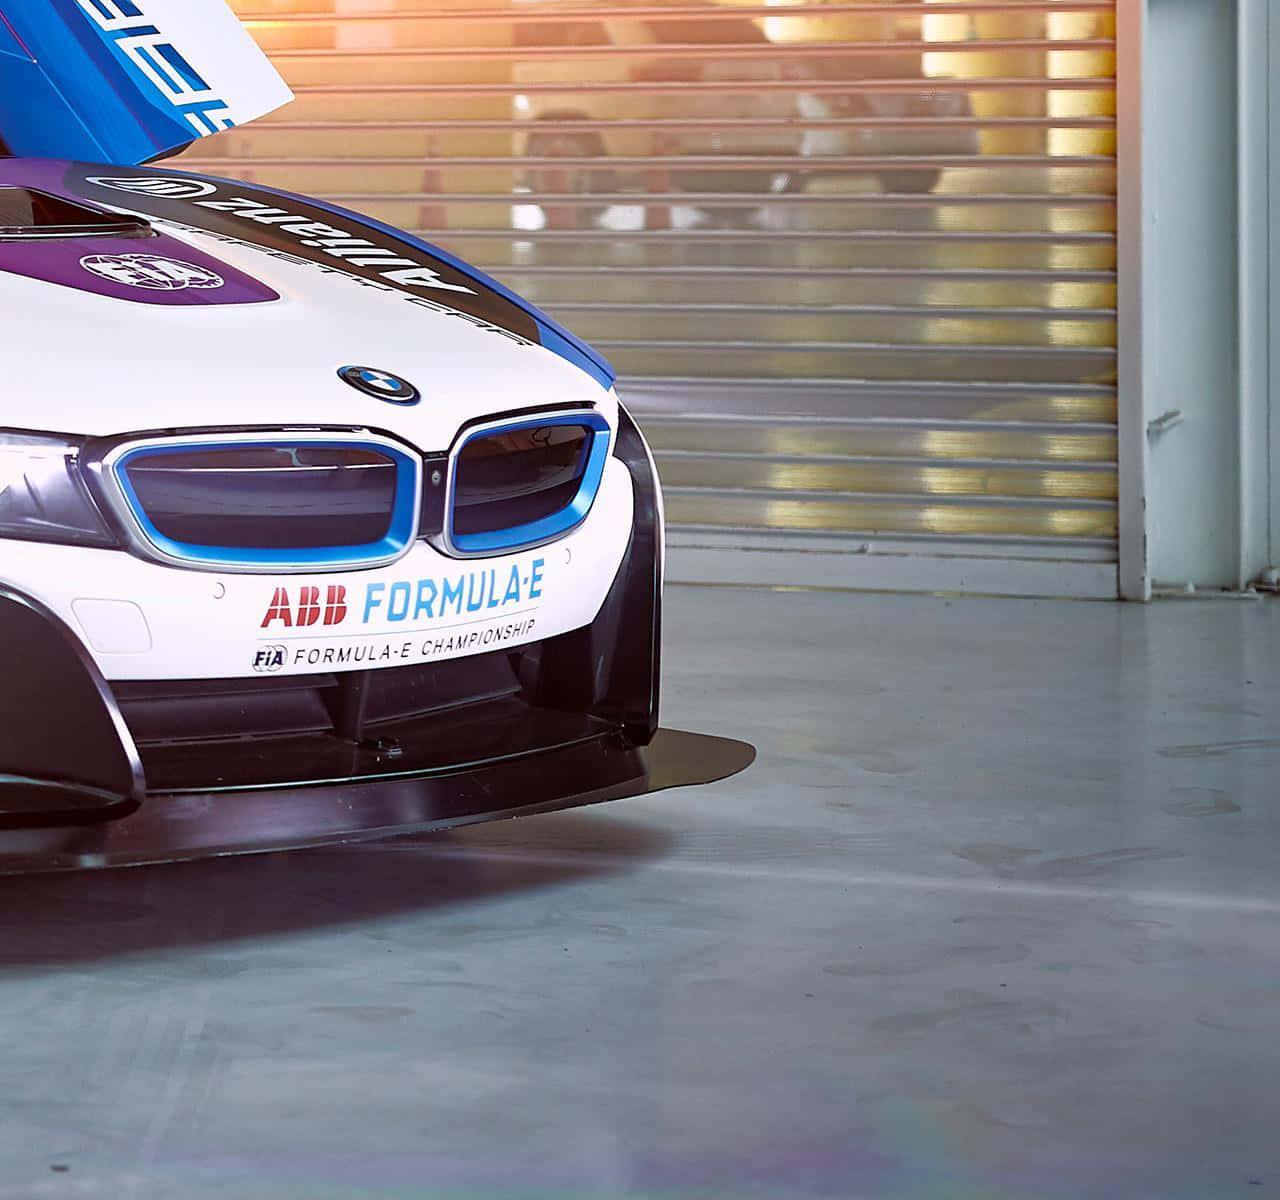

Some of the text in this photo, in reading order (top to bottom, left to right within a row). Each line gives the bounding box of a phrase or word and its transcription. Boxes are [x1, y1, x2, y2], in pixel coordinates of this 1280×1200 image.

[194, 197, 479, 296] Allianz
[259, 585, 350, 629] ABB
[421, 618, 537, 657] CHAMPIONSHIP
